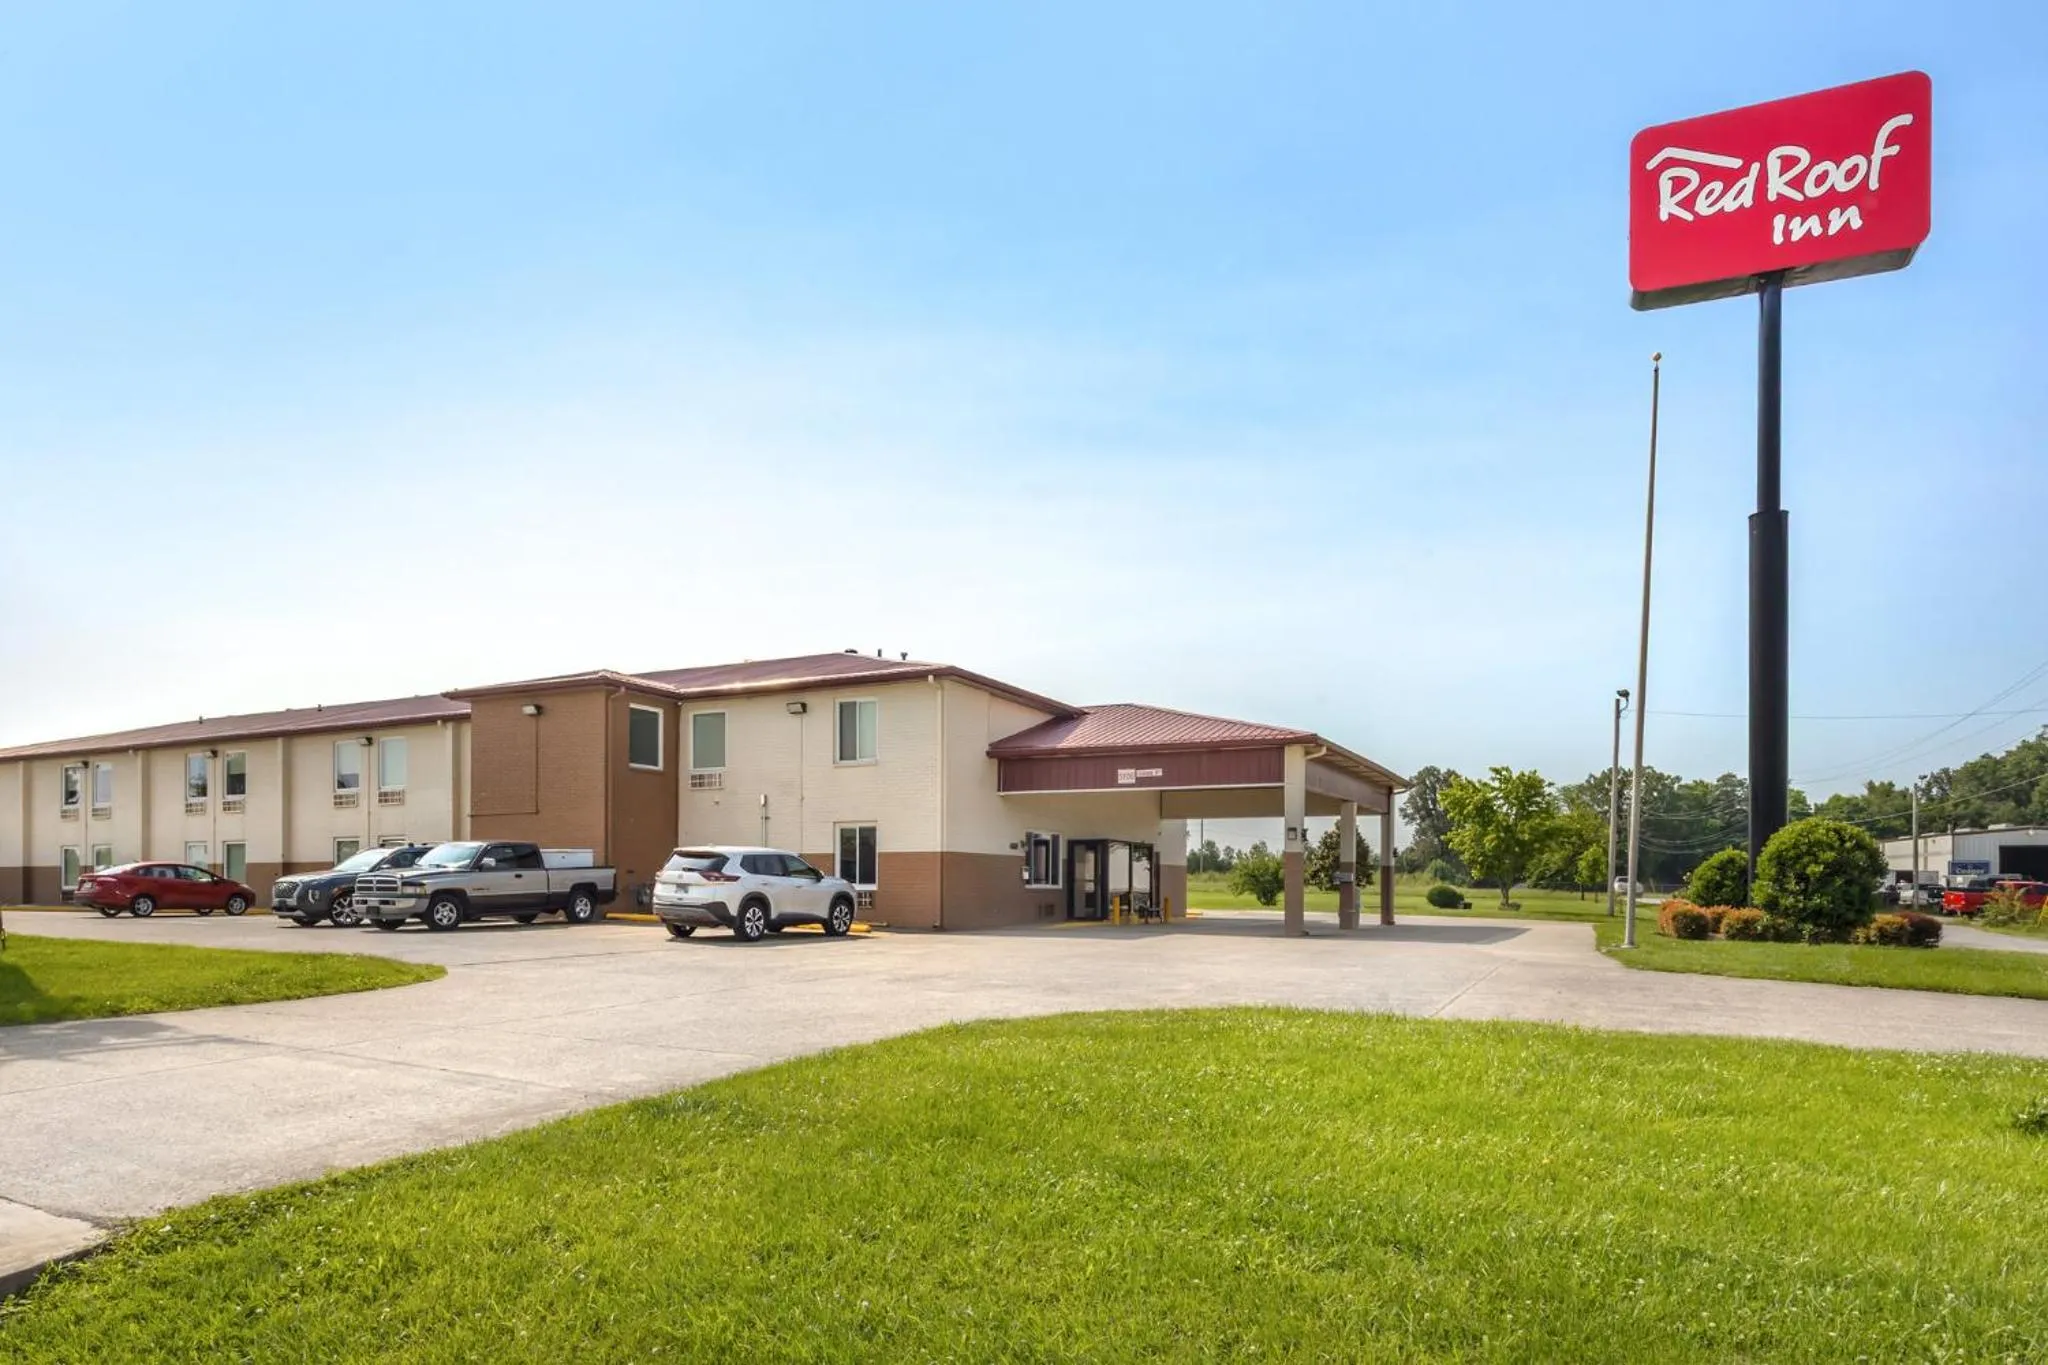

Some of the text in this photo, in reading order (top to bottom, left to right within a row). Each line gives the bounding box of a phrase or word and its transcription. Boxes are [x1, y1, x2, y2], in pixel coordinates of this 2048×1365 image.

[1659, 113, 1913, 221] Red Roof
[1772, 205, 1862, 245] Inn
